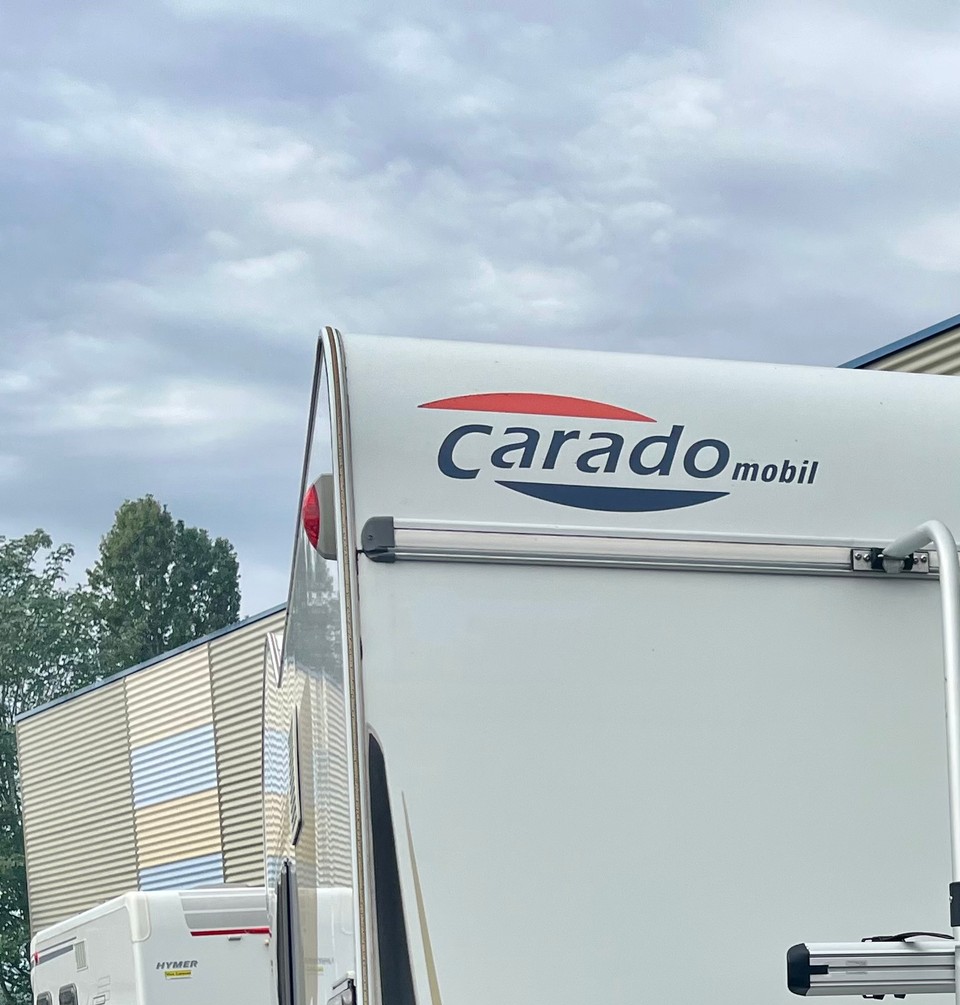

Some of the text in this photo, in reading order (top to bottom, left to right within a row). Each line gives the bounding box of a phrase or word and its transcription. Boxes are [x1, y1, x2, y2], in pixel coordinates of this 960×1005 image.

[437, 423, 819, 485] Carado mobil
[156, 960, 199, 970] HYMER
